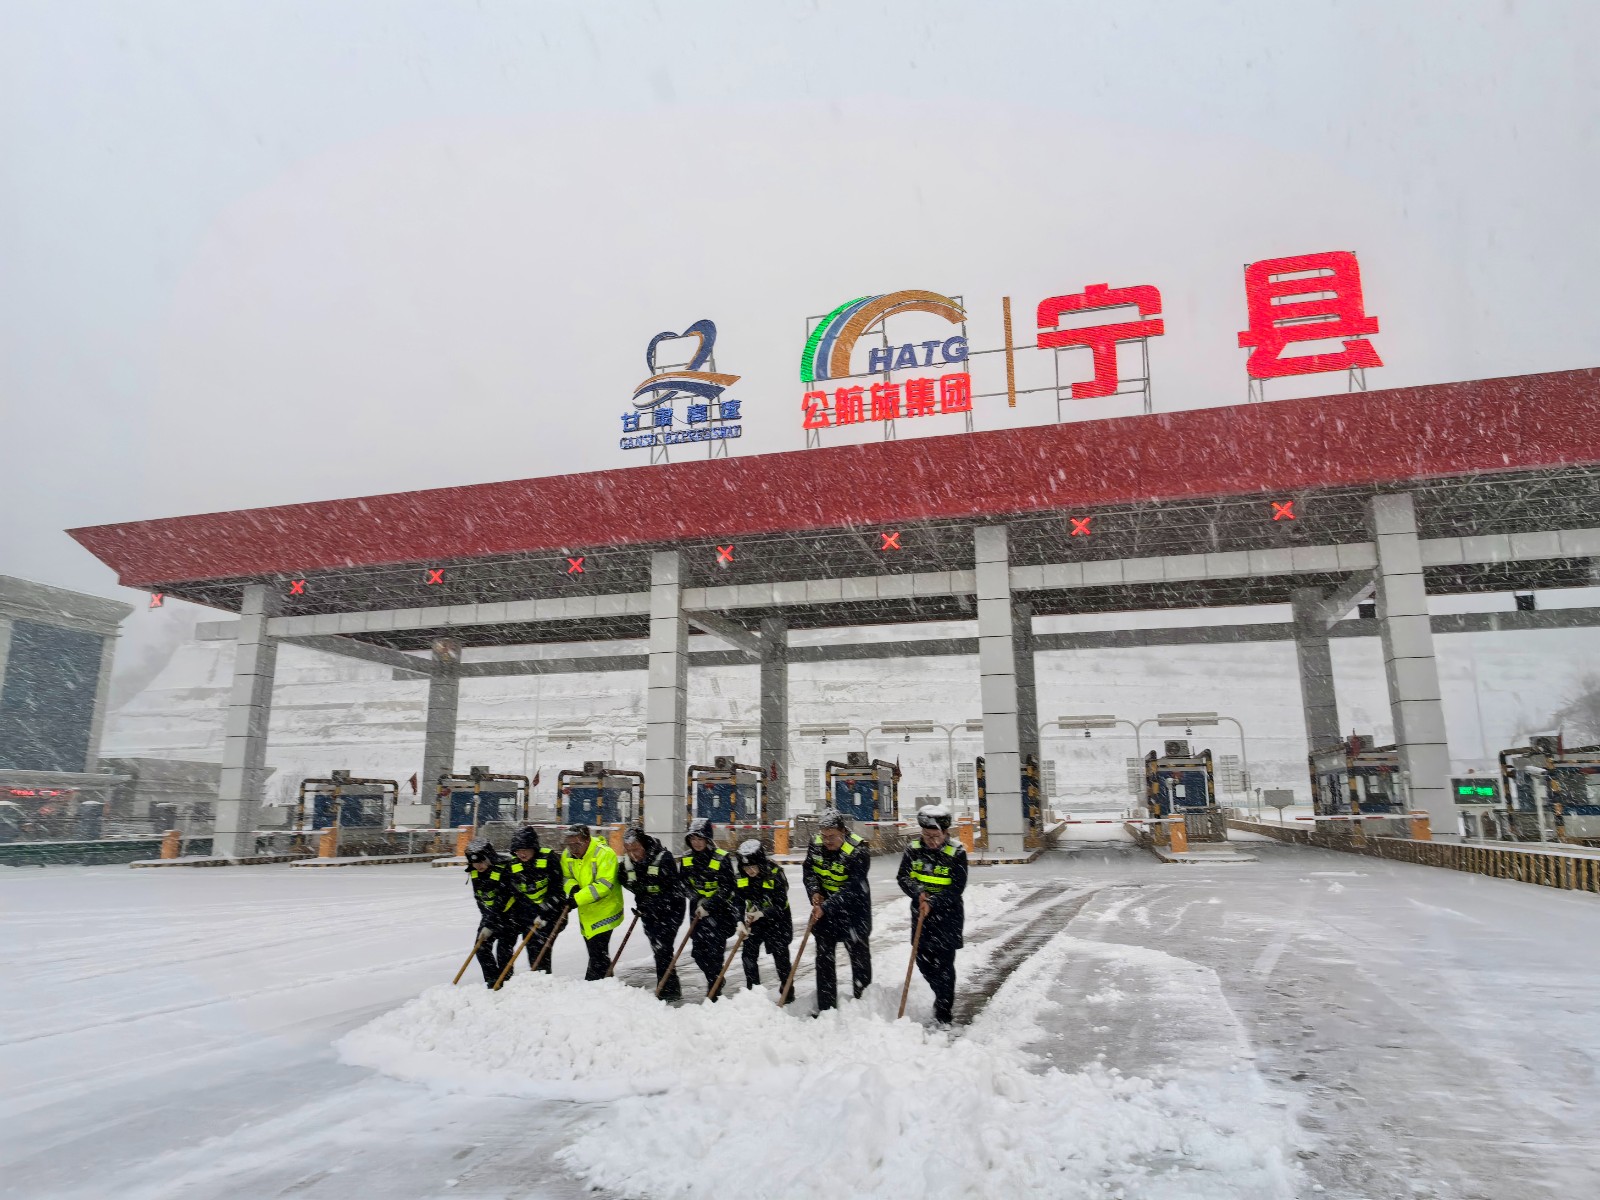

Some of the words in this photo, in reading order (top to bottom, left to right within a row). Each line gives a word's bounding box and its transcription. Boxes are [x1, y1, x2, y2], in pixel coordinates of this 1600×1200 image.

[1037, 251, 1384, 400] 宁县
[869, 336, 969, 374] HATG
[802, 373, 972, 429] 公航旅集团
